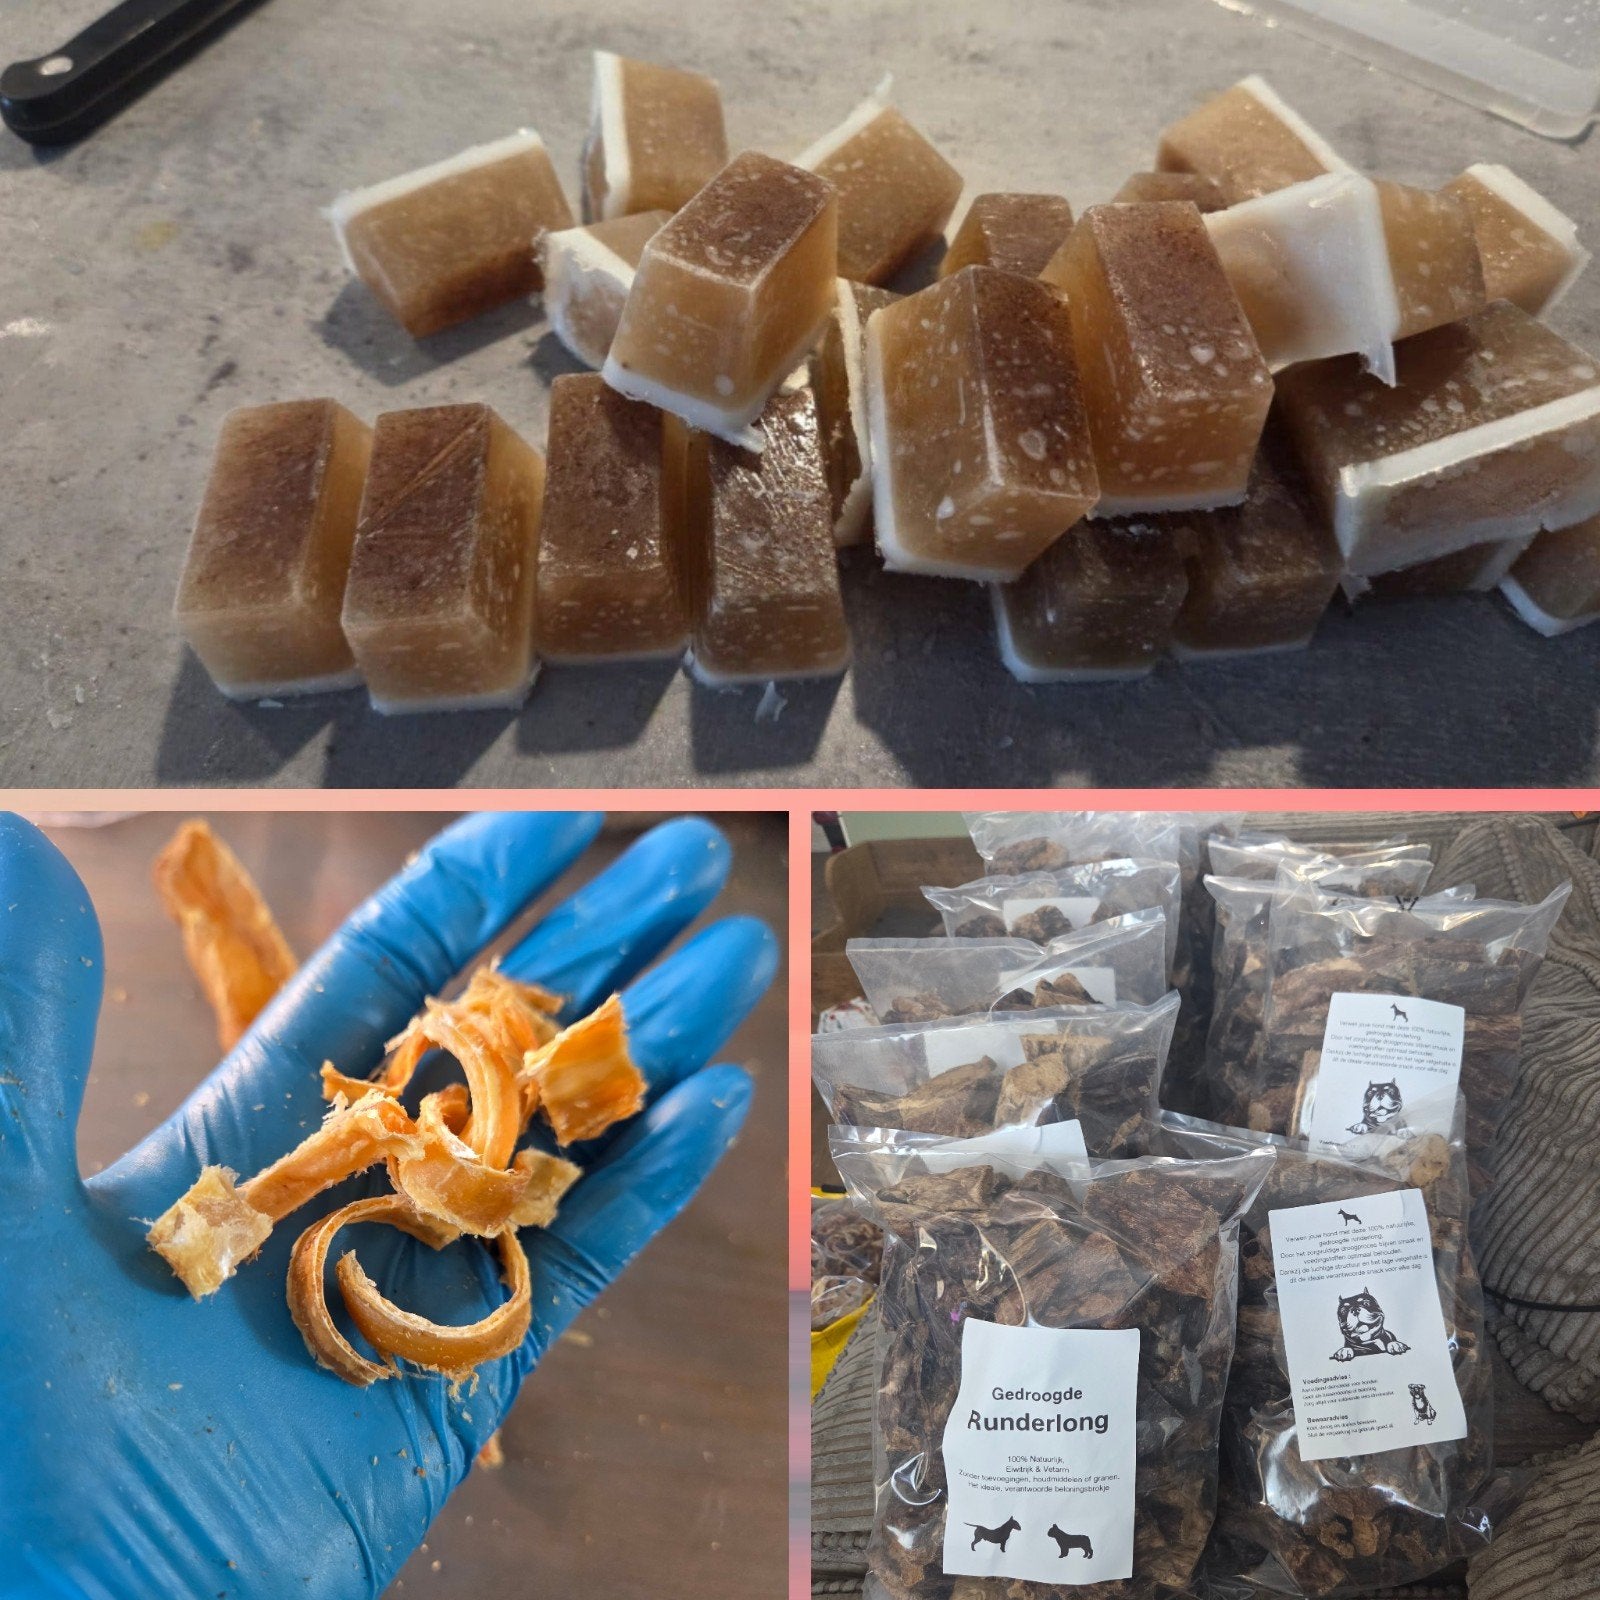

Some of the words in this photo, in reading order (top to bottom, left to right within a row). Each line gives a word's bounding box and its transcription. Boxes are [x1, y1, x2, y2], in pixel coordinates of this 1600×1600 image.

[1319, 1238, 1350, 1247] gedroogde
[1326, 1271, 1366, 1279] verantwoorde
[992, 1386, 1083, 1405] Gedroogde
[967, 1409, 1109, 1434] Runderlong
[1007, 1455, 1028, 1463] 100%
[1043, 1465, 1070, 1473] Vetarm
[981, 1475, 1031, 1483] toevoegingen,
